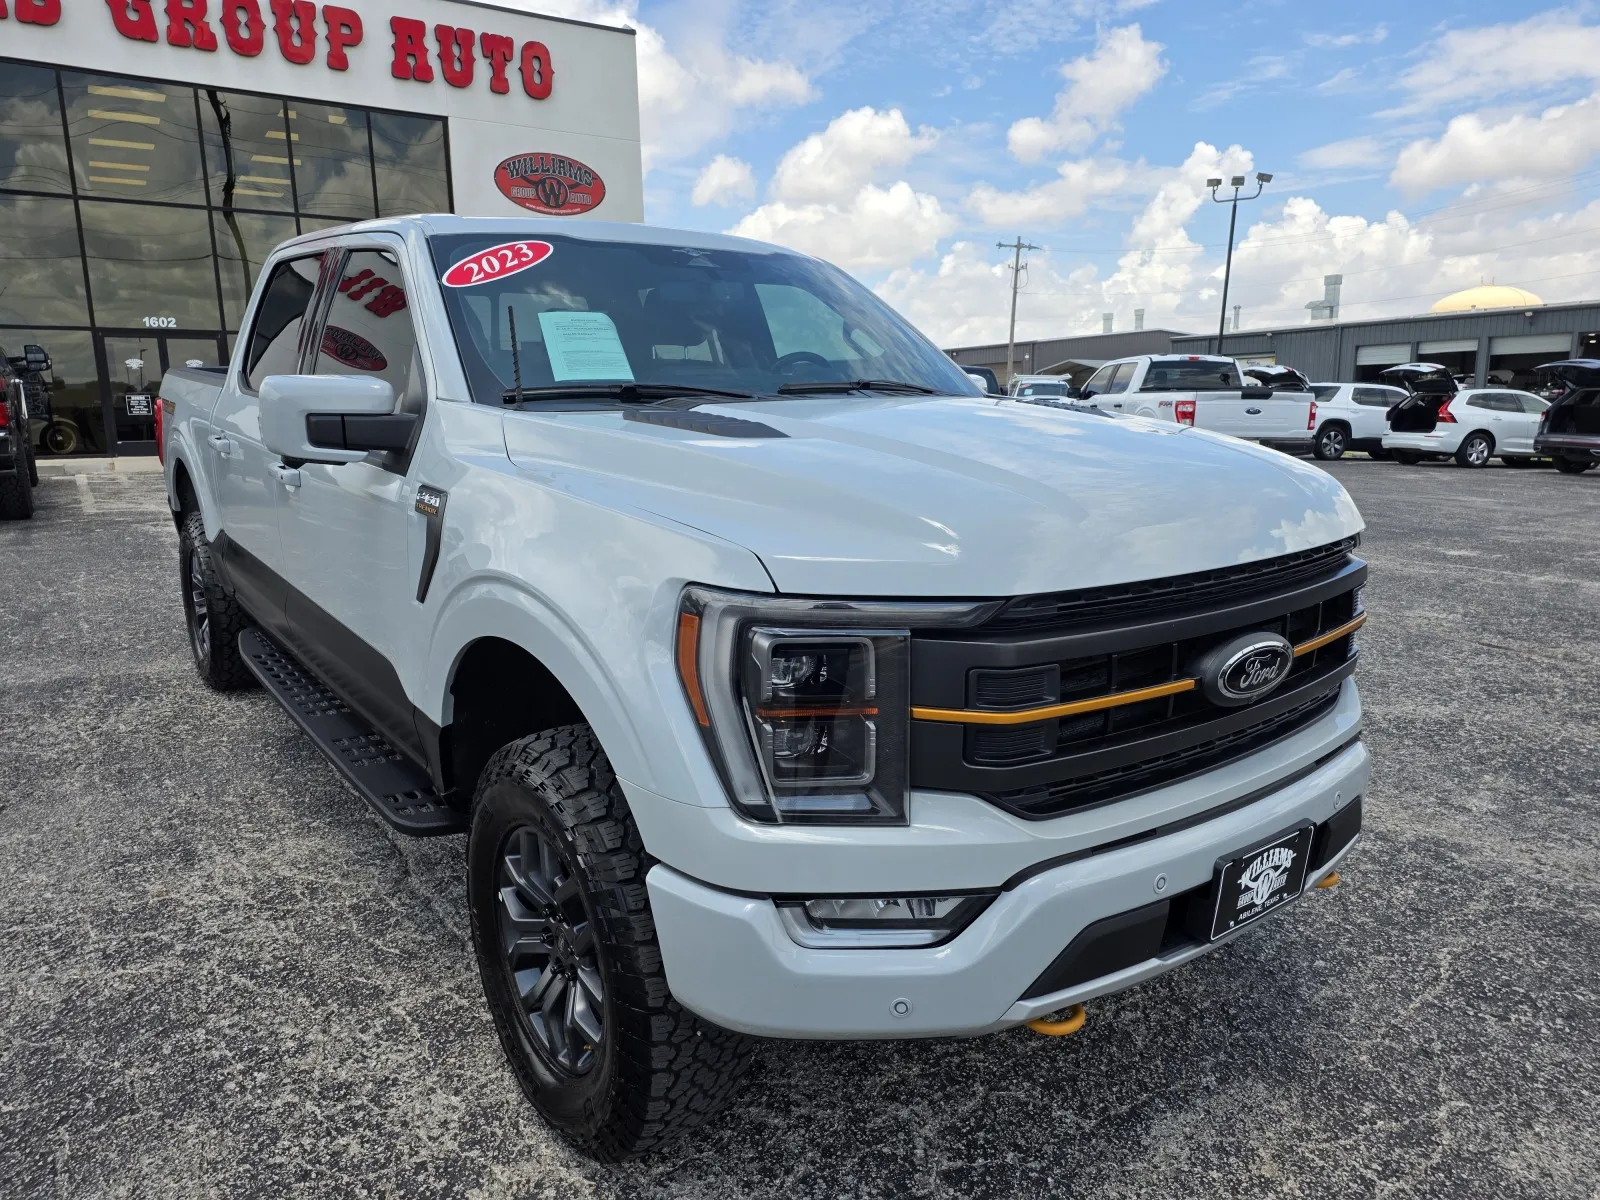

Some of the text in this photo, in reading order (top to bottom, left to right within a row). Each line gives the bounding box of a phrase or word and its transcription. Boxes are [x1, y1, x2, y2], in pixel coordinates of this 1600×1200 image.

[105, 0, 556, 100] GROUP AUTO
[506, 156, 593, 188] WILLIAMS
[463, 243, 534, 283] 2023
[142, 316, 177, 328] 1602
[1239, 653, 1281, 688] Ford
[1240, 847, 1294, 890] WILLIAMS
[1264, 894, 1280, 908] TEXAS
